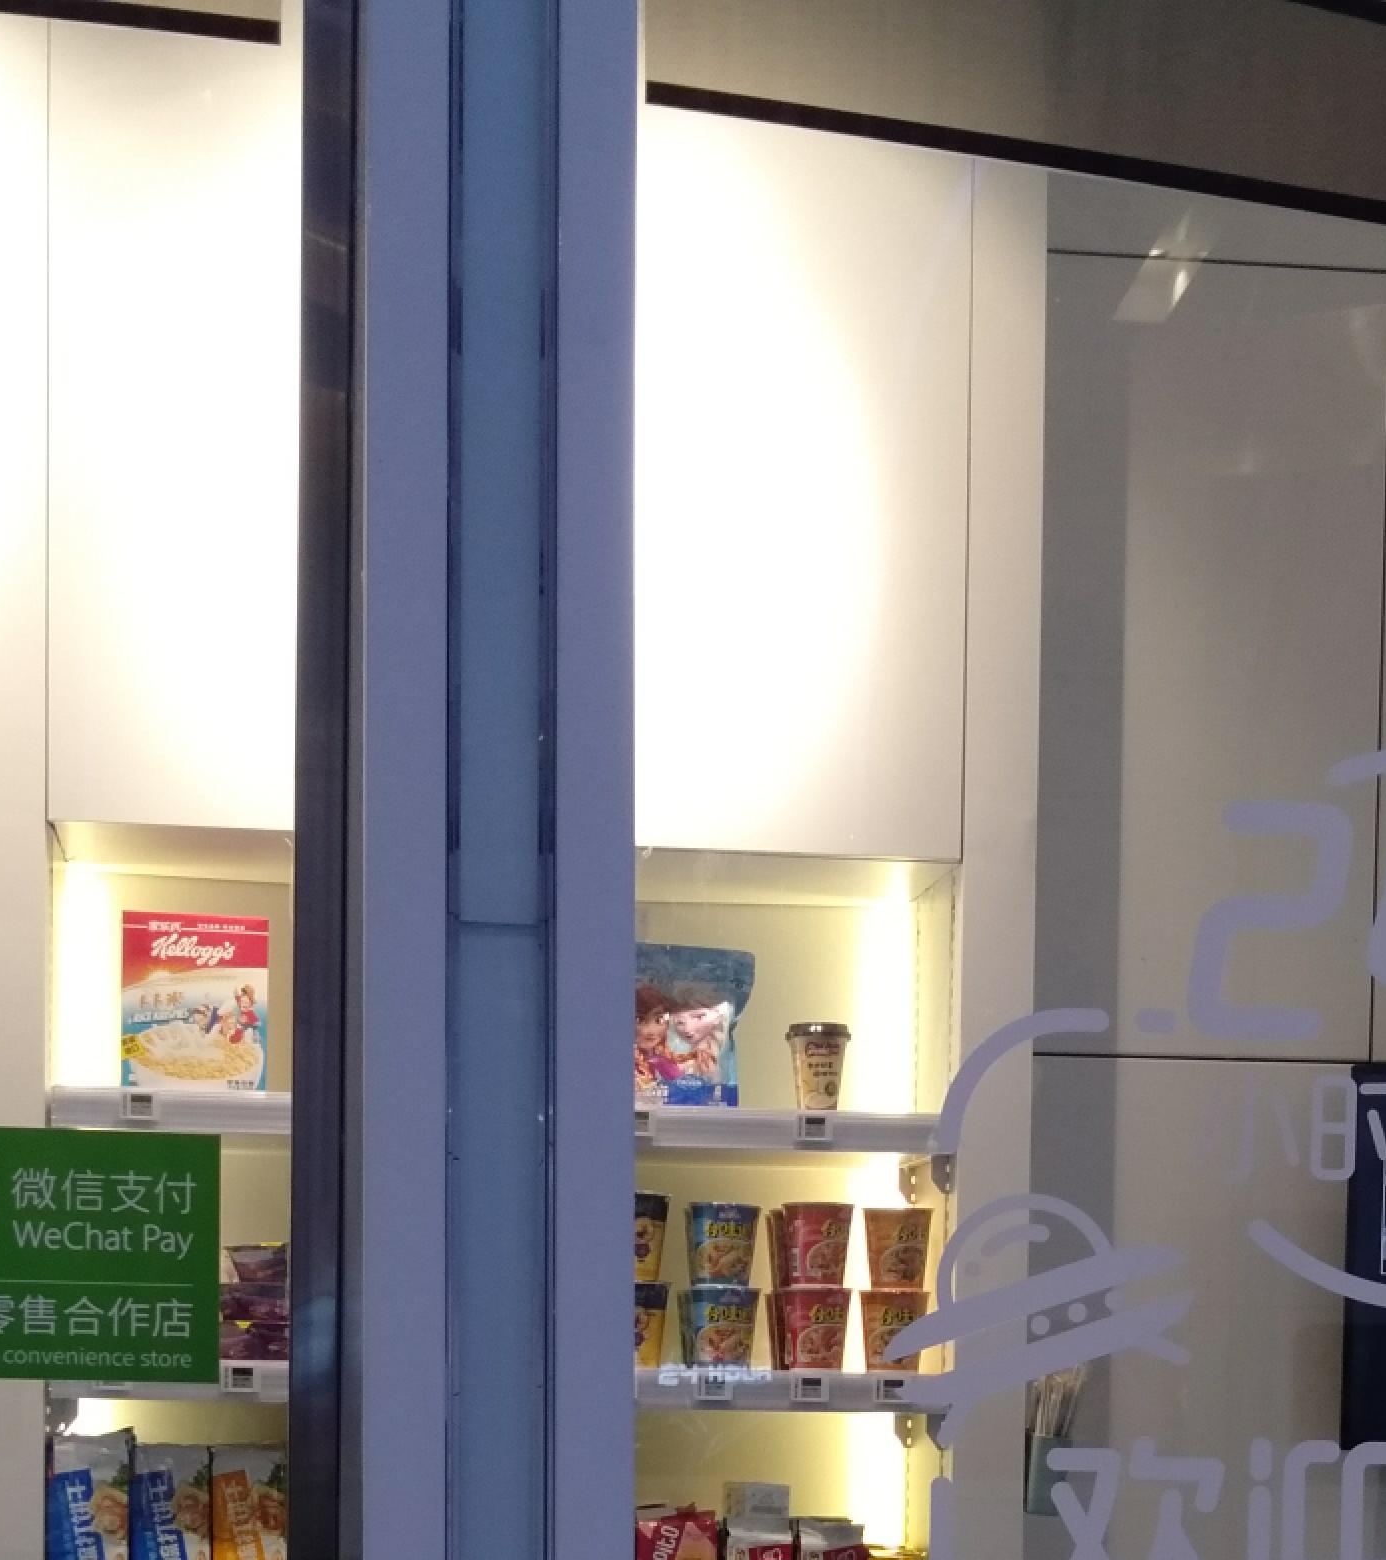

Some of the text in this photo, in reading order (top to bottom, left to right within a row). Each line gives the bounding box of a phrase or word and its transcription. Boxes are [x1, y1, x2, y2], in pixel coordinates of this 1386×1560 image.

[150, 933, 236, 966] Kellogg's
[11, 1167, 197, 1215] 微信支付
[12, 1220, 195, 1260] WeChat Pay
[2, 1346, 136, 1368] convenience
[141, 1351, 193, 1369] store
